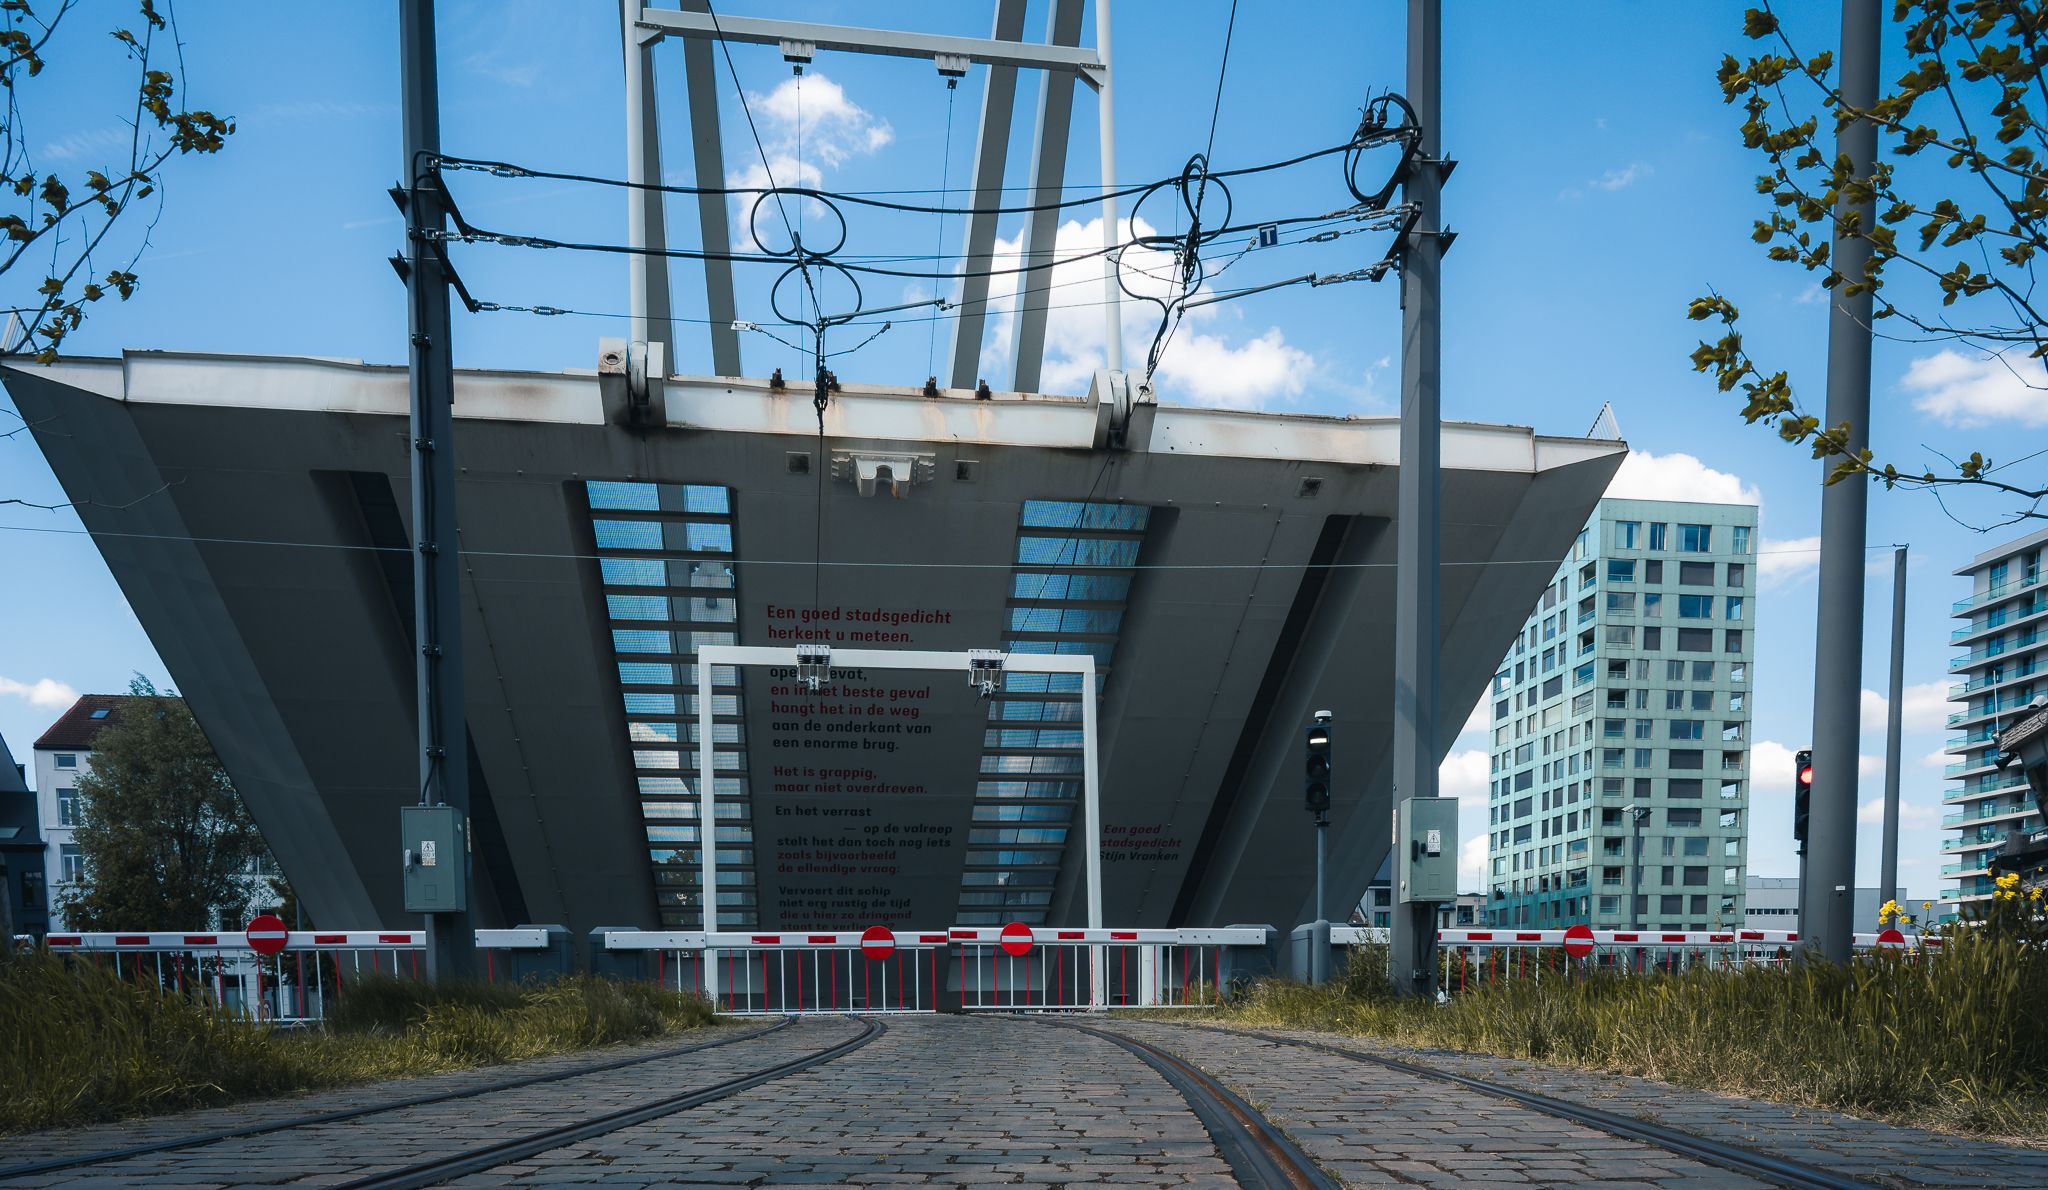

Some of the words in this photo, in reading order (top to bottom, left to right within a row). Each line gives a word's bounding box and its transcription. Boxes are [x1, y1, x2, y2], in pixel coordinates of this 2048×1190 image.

[767, 605, 795, 620] Een
[801, 606, 840, 623] goed
[846, 608, 952, 626] stadsgedicht
[768, 625, 831, 641] herkent
[836, 631, 844, 641] u
[851, 630, 913, 642] meteen.
[770, 667, 797, 681] ope
[830, 668, 867, 681] evat,
[770, 686, 789, 696] en
[794, 685, 806, 696] in
[843, 685, 884, 698] beste
[890, 686, 930, 701] geval
[771, 701, 815, 716] hangt
[820, 703, 844, 714] het
[849, 704, 862, 715] in
[867, 704, 884, 715] de
[890, 705, 919, 719] weg
[772, 721, 799, 731] aan
[804, 720, 821, 731] de
[826, 721, 901, 733] onderkant
[906, 724, 932, 734] van
[773, 739, 799, 748] een
[804, 739, 858, 749] enorme
[863, 739, 899, 752] brug.
[774, 766, 799, 776] Het
[803, 767, 815, 777] is
[819, 767, 877, 780] grappig,
[774, 783, 810, 792] maar
[815, 783, 842, 793] niet
[846, 783, 928, 794] overdreven.
[775, 806, 791, 816] En
[795, 806, 818, 816] het
[823, 807, 872, 817] verrast
[864, 825, 879, 834] op
[884, 824, 899, 833] de
[904, 824, 953, 834] valreep
[1104, 824, 1126, 833] Een
[1130, 824, 1162, 836] goed
[777, 837, 808, 846] stelt
[812, 837, 834, 846] het
[838, 838, 861, 847] dan
[866, 838, 895, 847] toch
[899, 839, 922, 850] nog
[926, 838, 951, 847] iets
[1100, 838, 1182, 849] stadsgedicht
[777, 850, 811, 860] zoals
[816, 850, 896, 862] bijvoorbeeld
[1130, 851, 1179, 861] Vranken
[778, 863, 793, 873] de
[797, 863, 856, 875] ellendige
[779, 886, 832, 895] Vervoert
[837, 886, 853, 895] dit
[857, 886, 891, 897] schip
[779, 898, 802, 907] niet
[808, 899, 827, 909] erg
[831, 898, 868, 909] rustig
[872, 898, 885, 907] de
[890, 898, 911, 909] tijd
[780, 910, 799, 919] die
[814, 910, 836, 919] hier
[841, 911, 854, 919] zo
[858, 911, 912, 921] dringend
